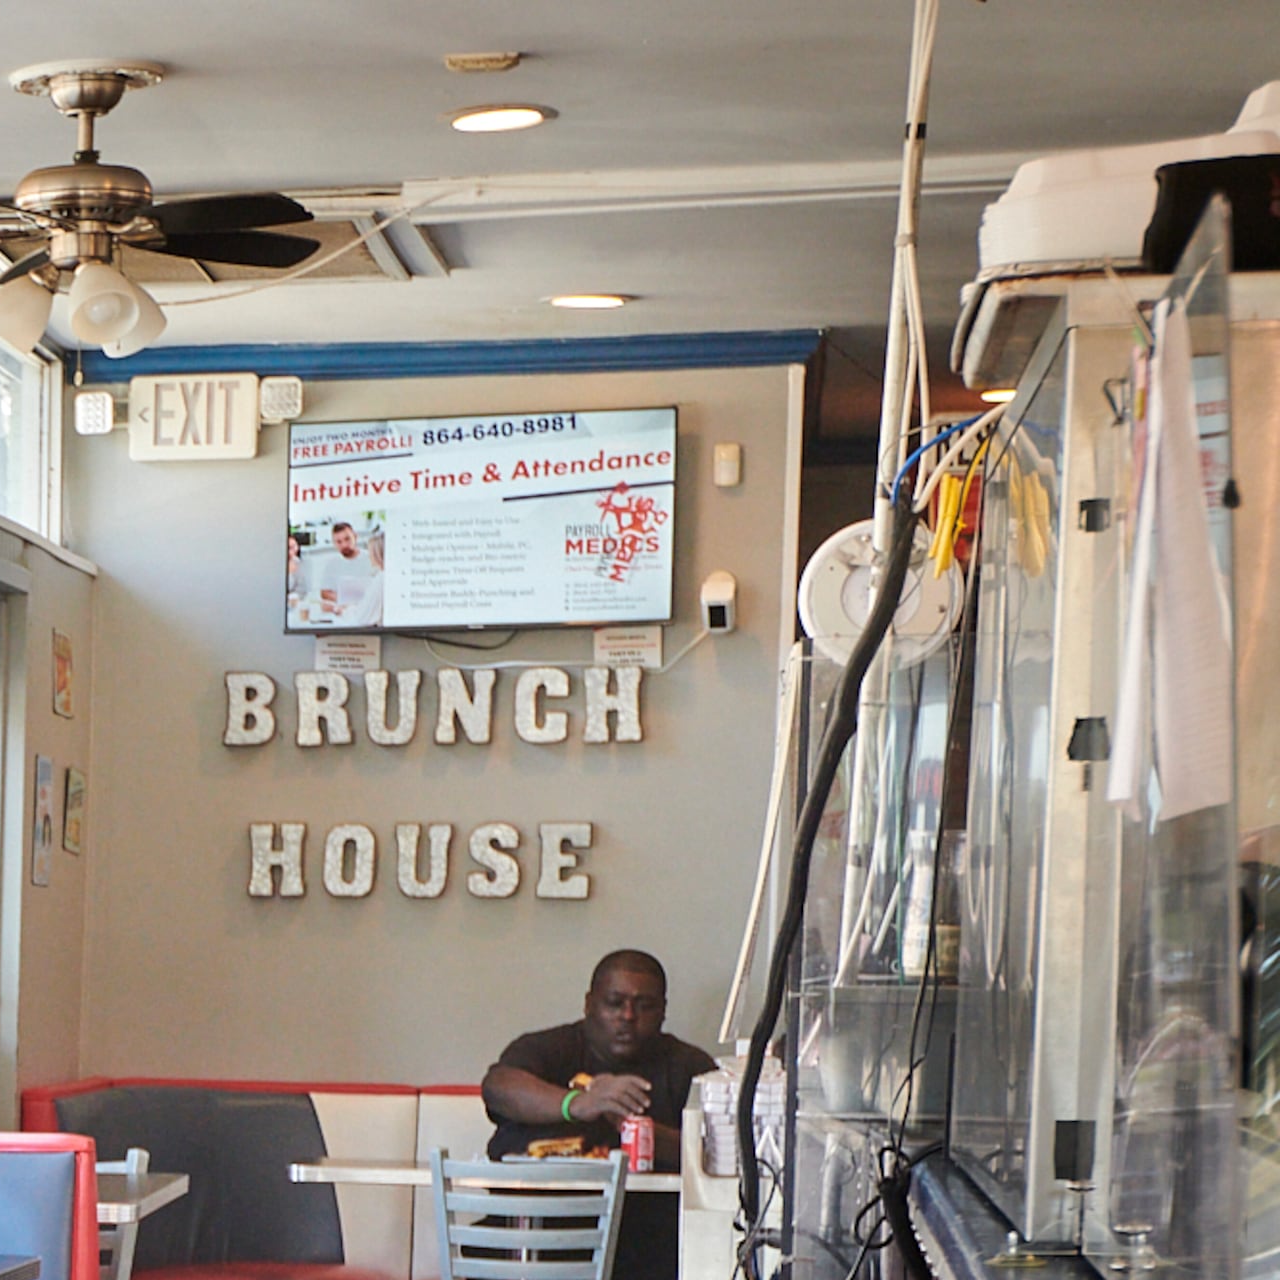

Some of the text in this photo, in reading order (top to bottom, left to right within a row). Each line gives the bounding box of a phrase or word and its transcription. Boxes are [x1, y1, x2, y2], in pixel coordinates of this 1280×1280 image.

[153, 380, 240, 446] EXIT
[423, 413, 577, 446] 864-640-8981
[292, 427, 394, 445] ENJOY TWO MONTHS
[293, 434, 413, 460] FREE PAYROLL!
[293, 450, 672, 502] Intuitive Time & Attendance
[565, 523, 612, 539] PAYROLL
[223, 666, 644, 747] BRUNCH
[248, 821, 594, 900] HOUSE
